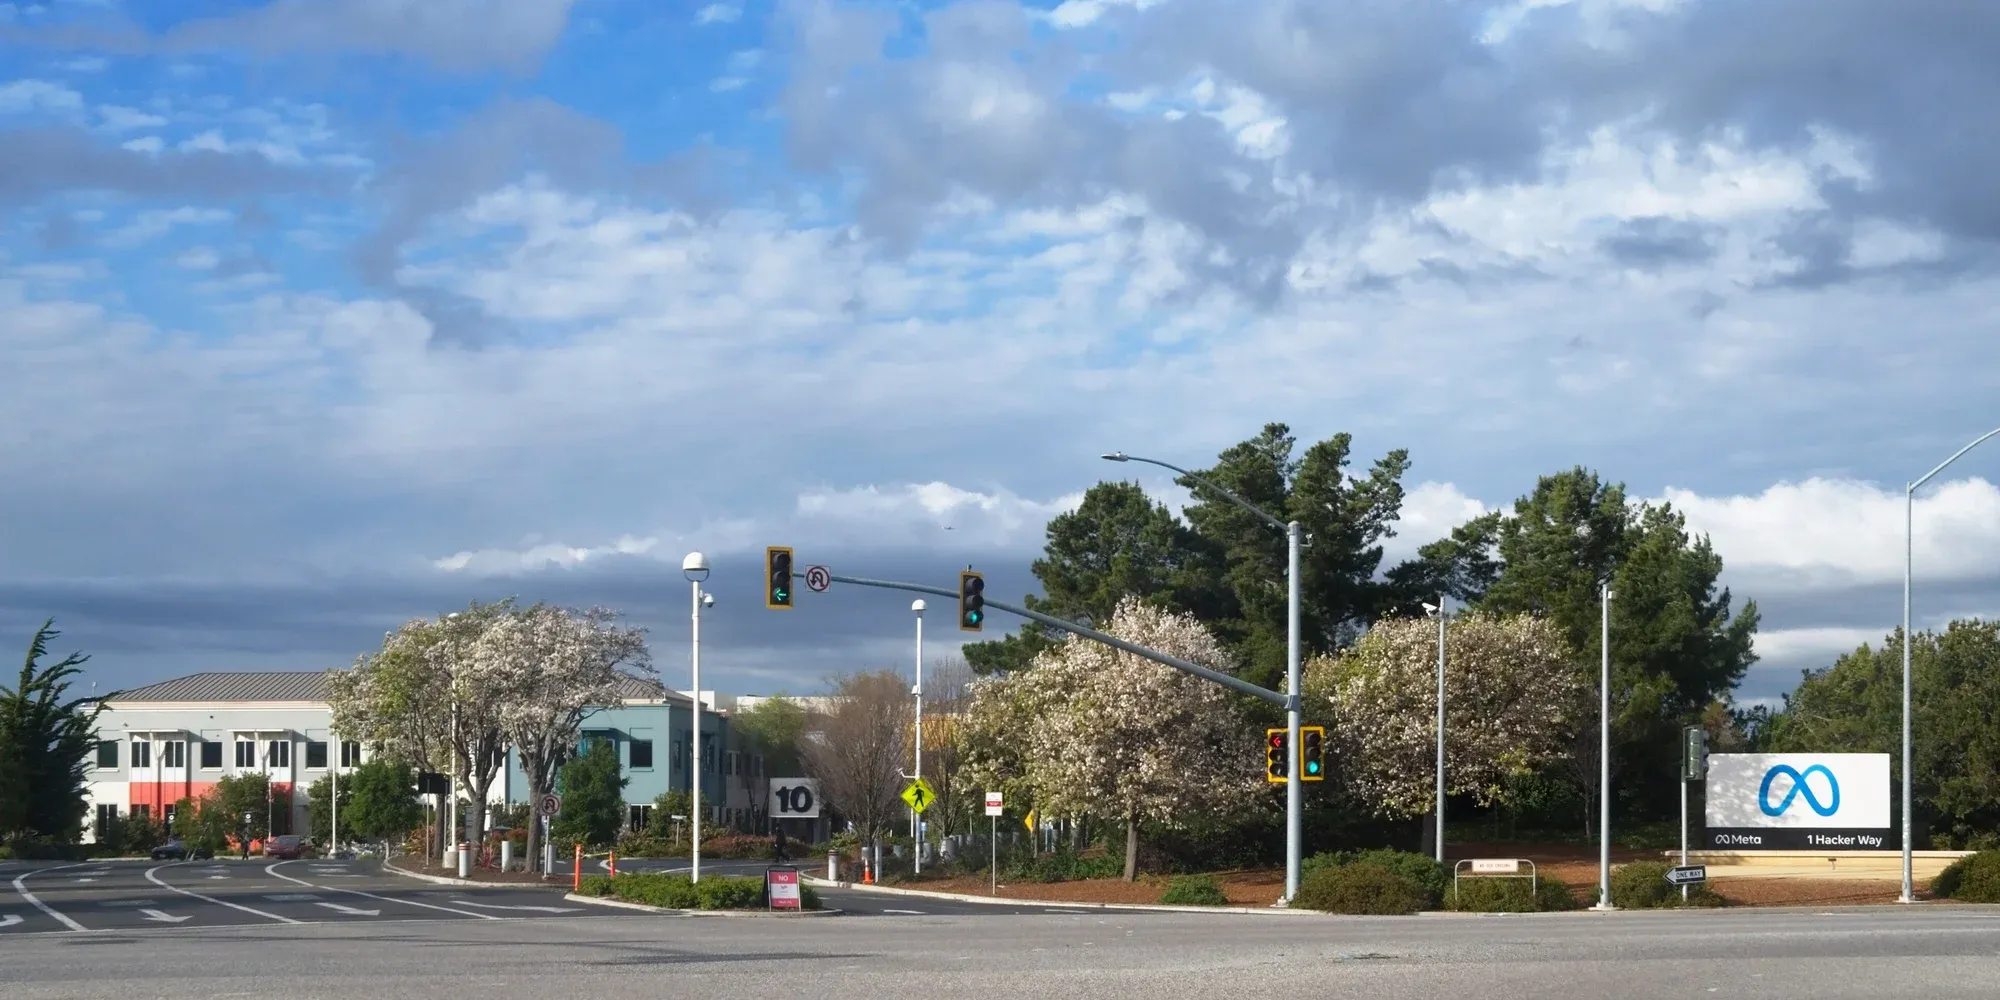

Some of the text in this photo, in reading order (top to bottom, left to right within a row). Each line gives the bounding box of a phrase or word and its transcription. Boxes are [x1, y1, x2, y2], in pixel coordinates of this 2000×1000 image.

[775, 786, 813, 813] 10
[1731, 834, 1762, 845] Meta
[1807, 834, 1883, 848] 1 Hacker Way
[778, 874, 789, 882] NO
[1675, 871, 1688, 879] ONE
